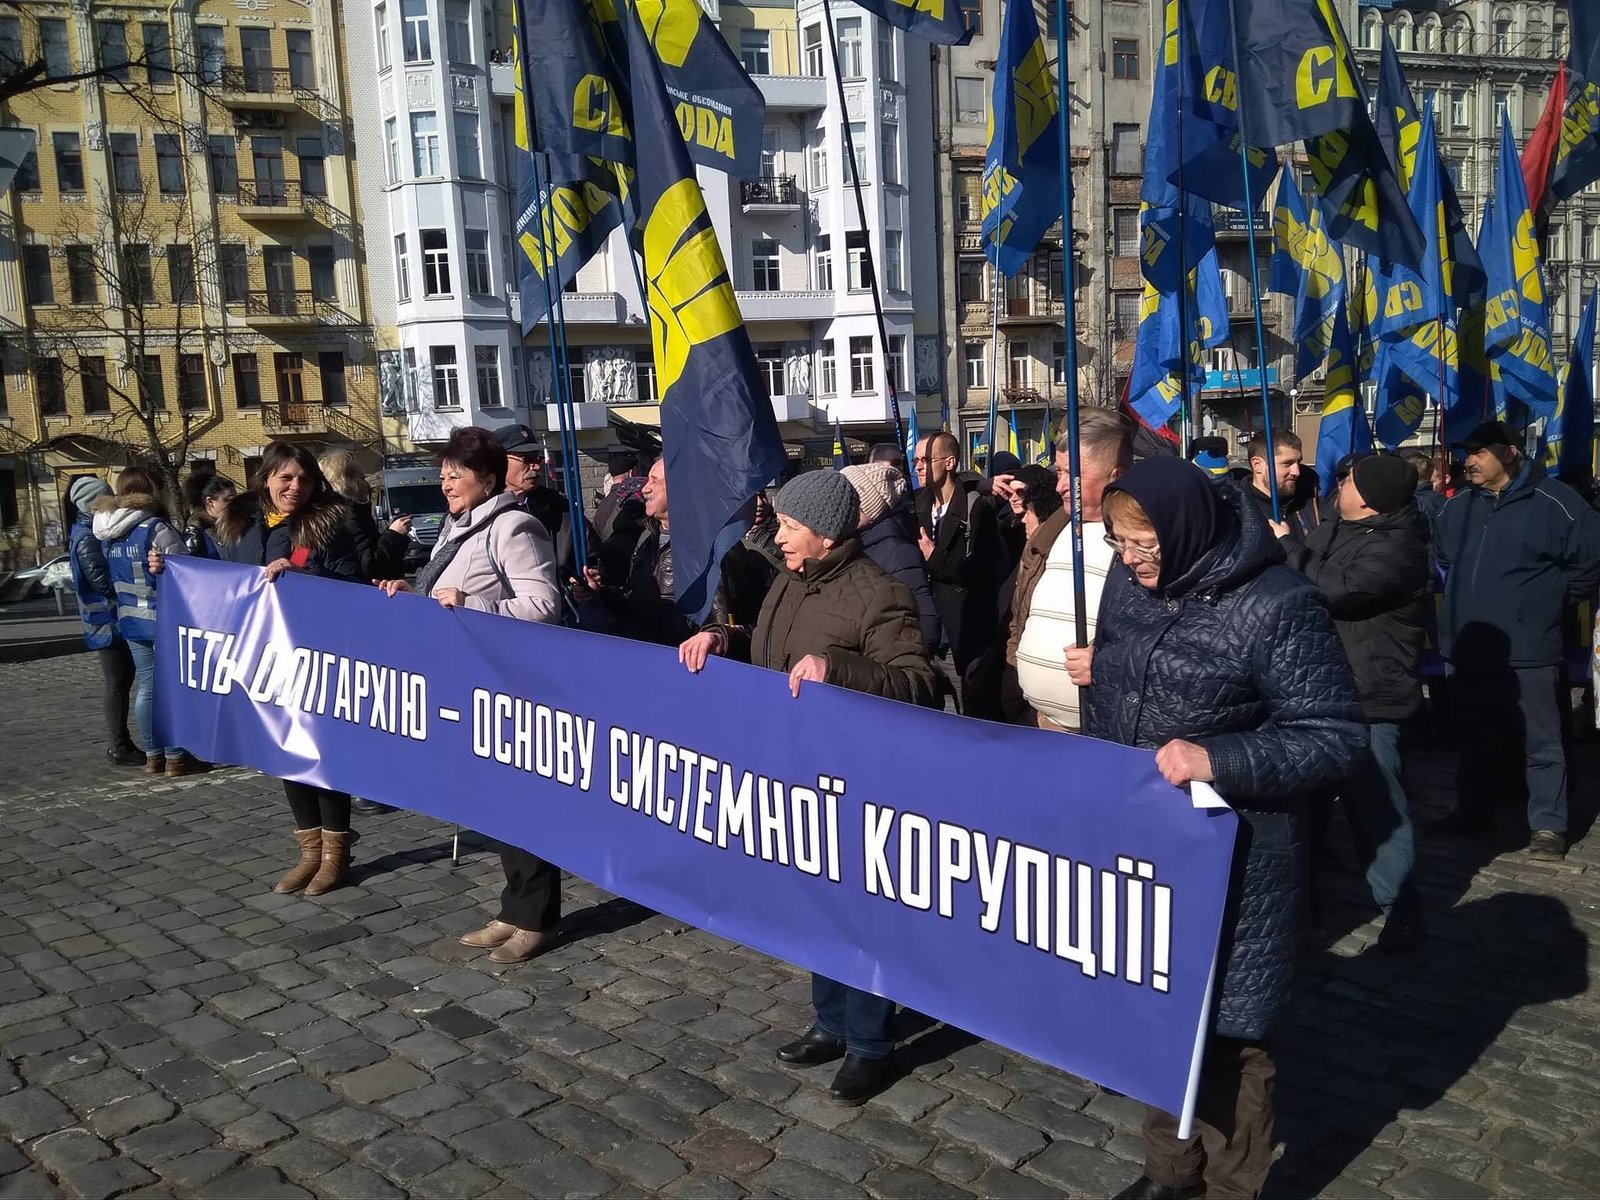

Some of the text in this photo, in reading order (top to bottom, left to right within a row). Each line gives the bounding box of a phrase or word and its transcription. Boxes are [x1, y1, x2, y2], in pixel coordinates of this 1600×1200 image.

[178, 625, 237, 696] ГЕТЬ
[472, 687, 597, 793] ОСНОВУ
[608, 725, 846, 884] СИСТЕМНОЇ
[862, 800, 1174, 995] КОРУПЦІЇ!
